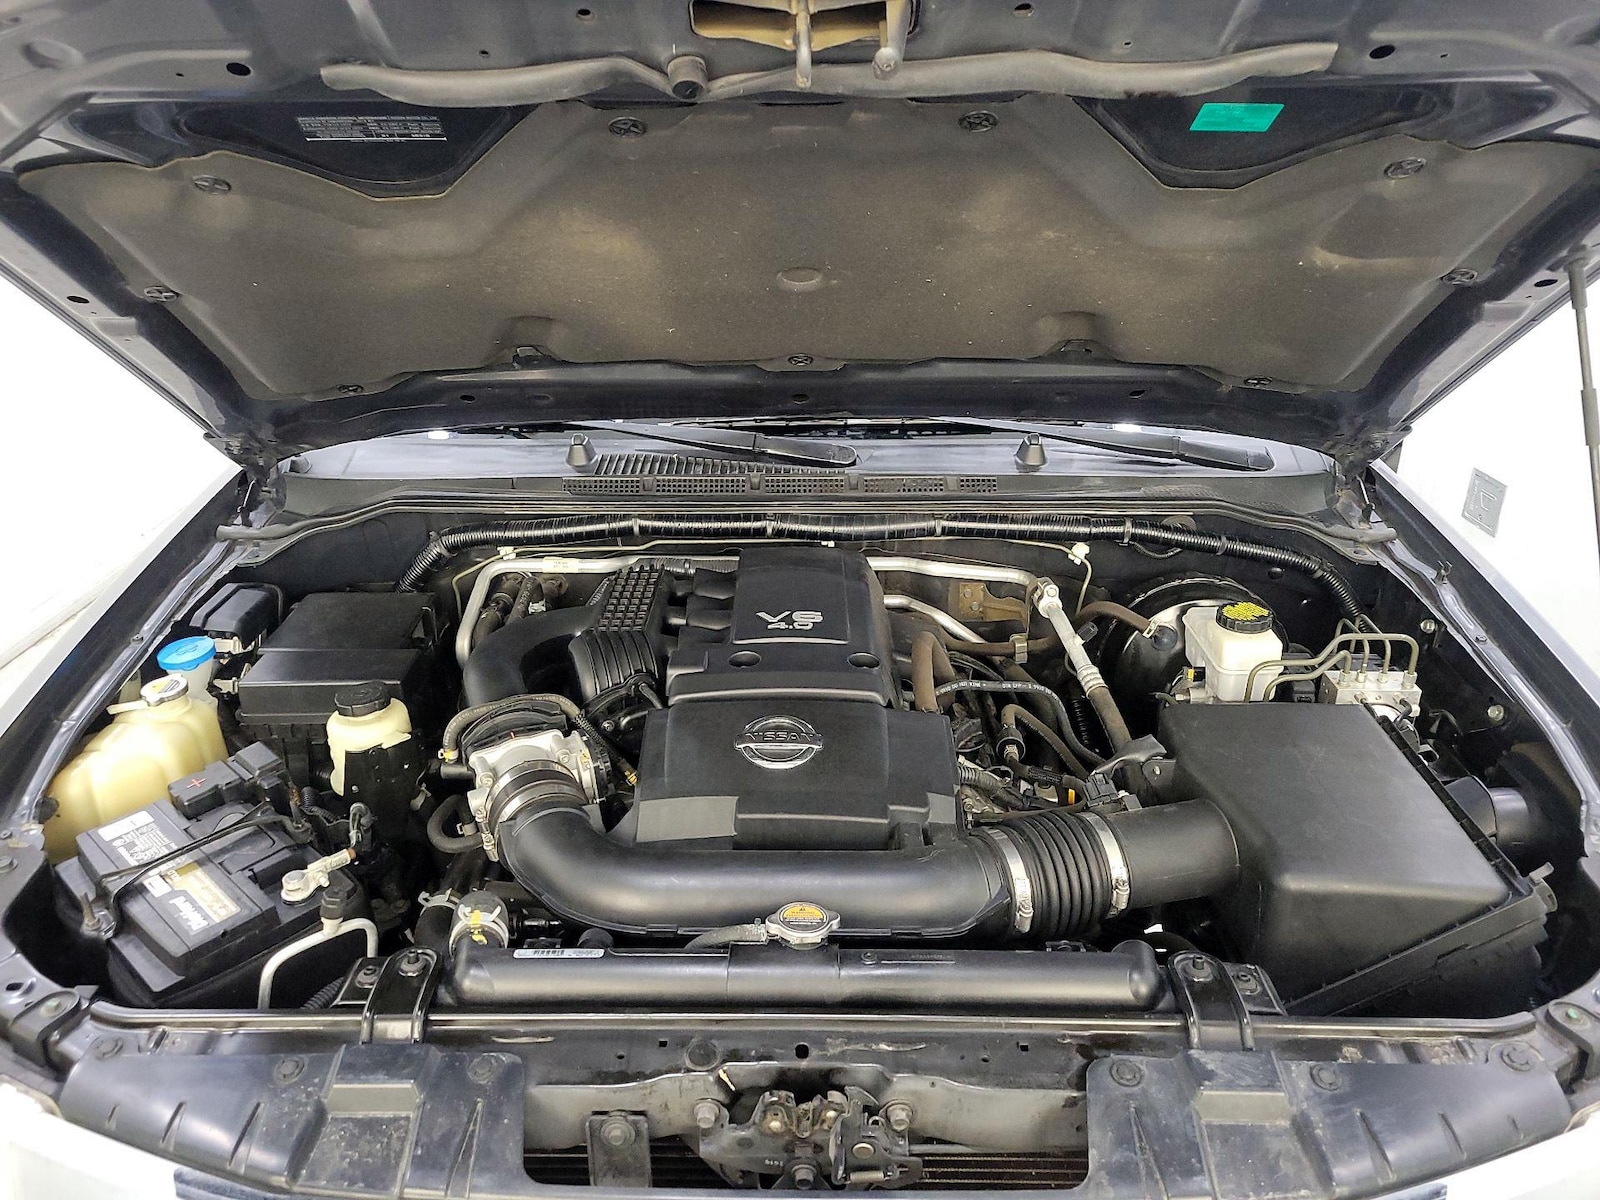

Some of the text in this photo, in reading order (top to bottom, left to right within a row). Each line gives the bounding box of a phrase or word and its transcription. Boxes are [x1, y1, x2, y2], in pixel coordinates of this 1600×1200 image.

[755, 610, 824, 623] V6
[767, 621, 814, 630] 4.0
[744, 731, 814, 742] NISSAN
